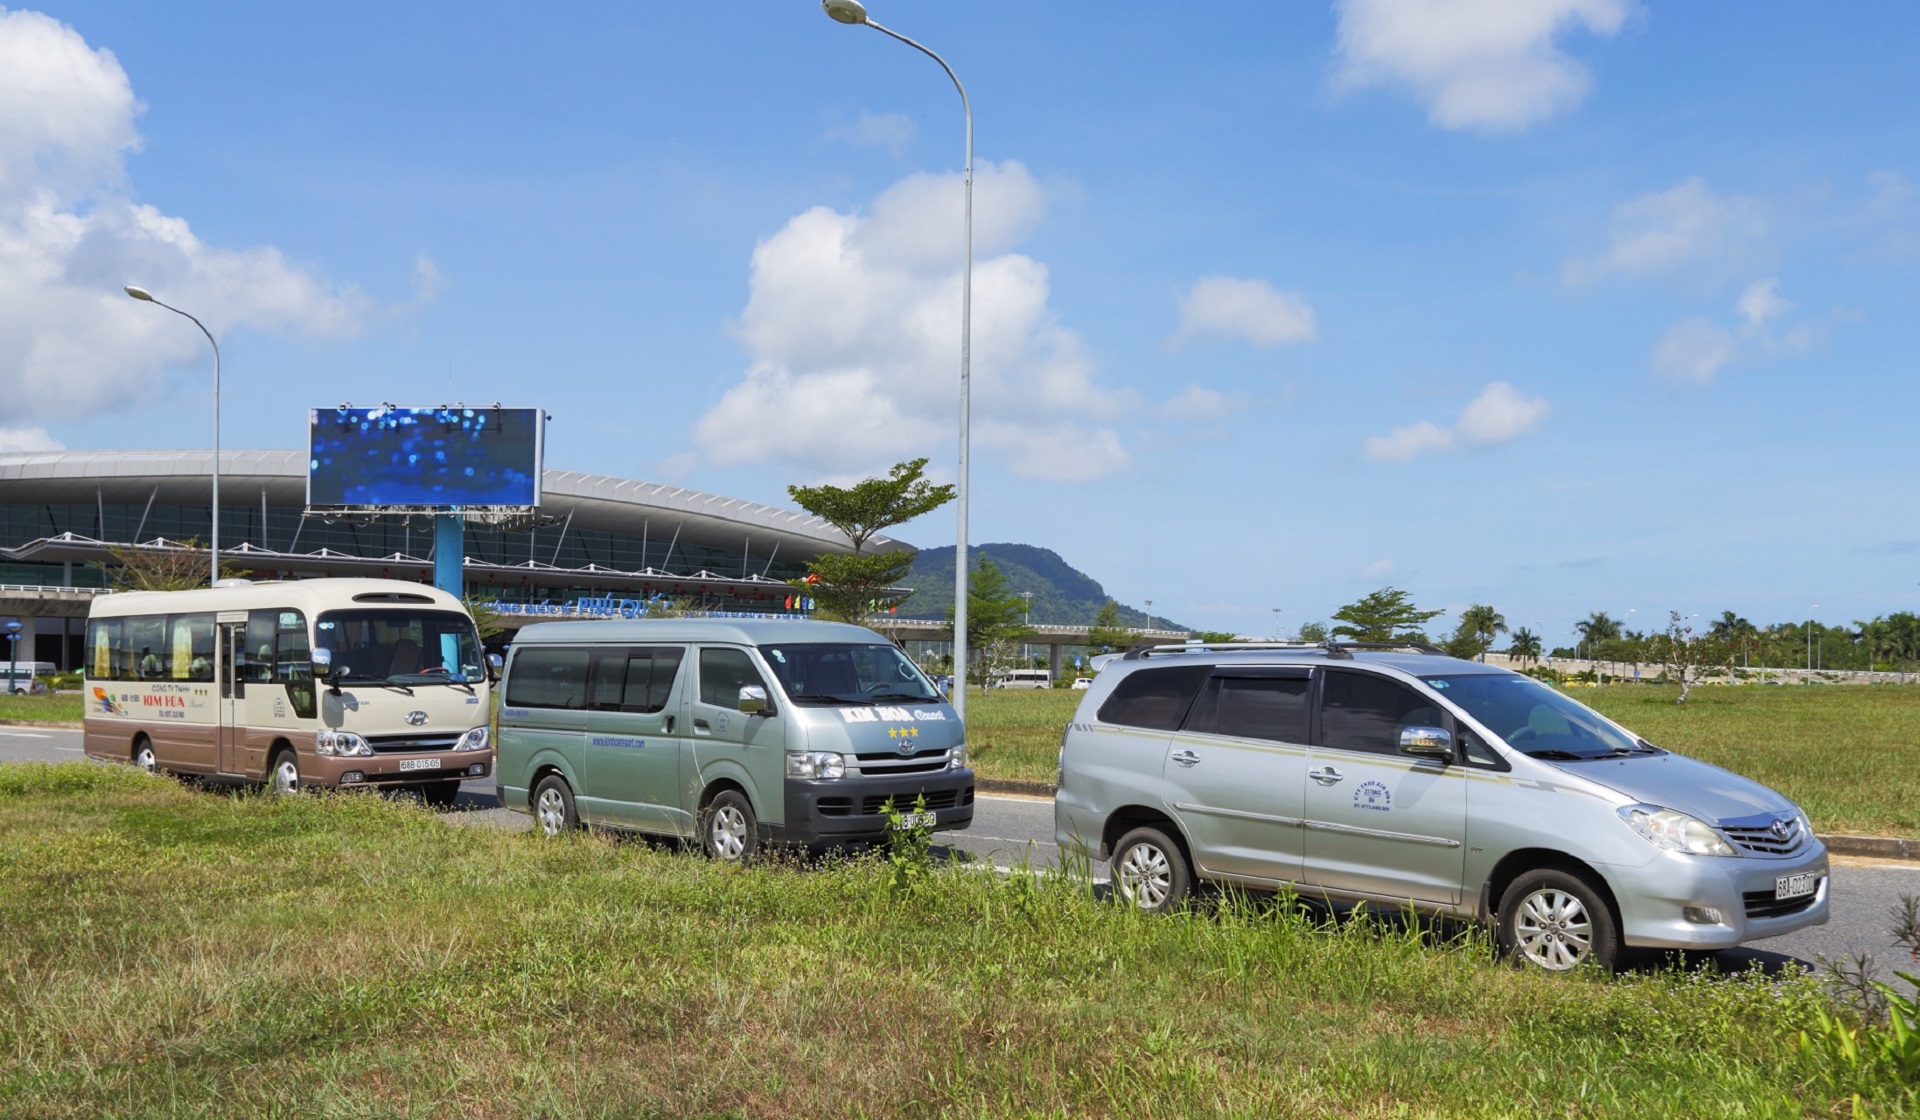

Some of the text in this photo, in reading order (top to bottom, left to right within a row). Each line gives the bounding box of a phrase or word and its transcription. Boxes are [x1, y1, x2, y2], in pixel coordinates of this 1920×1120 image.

[578, 592, 614, 617] PHÚ
[143, 694, 162, 707] KIM
[165, 695, 185, 708] HOA
[839, 707, 878, 723] KIM
[875, 707, 915, 721] HOA
